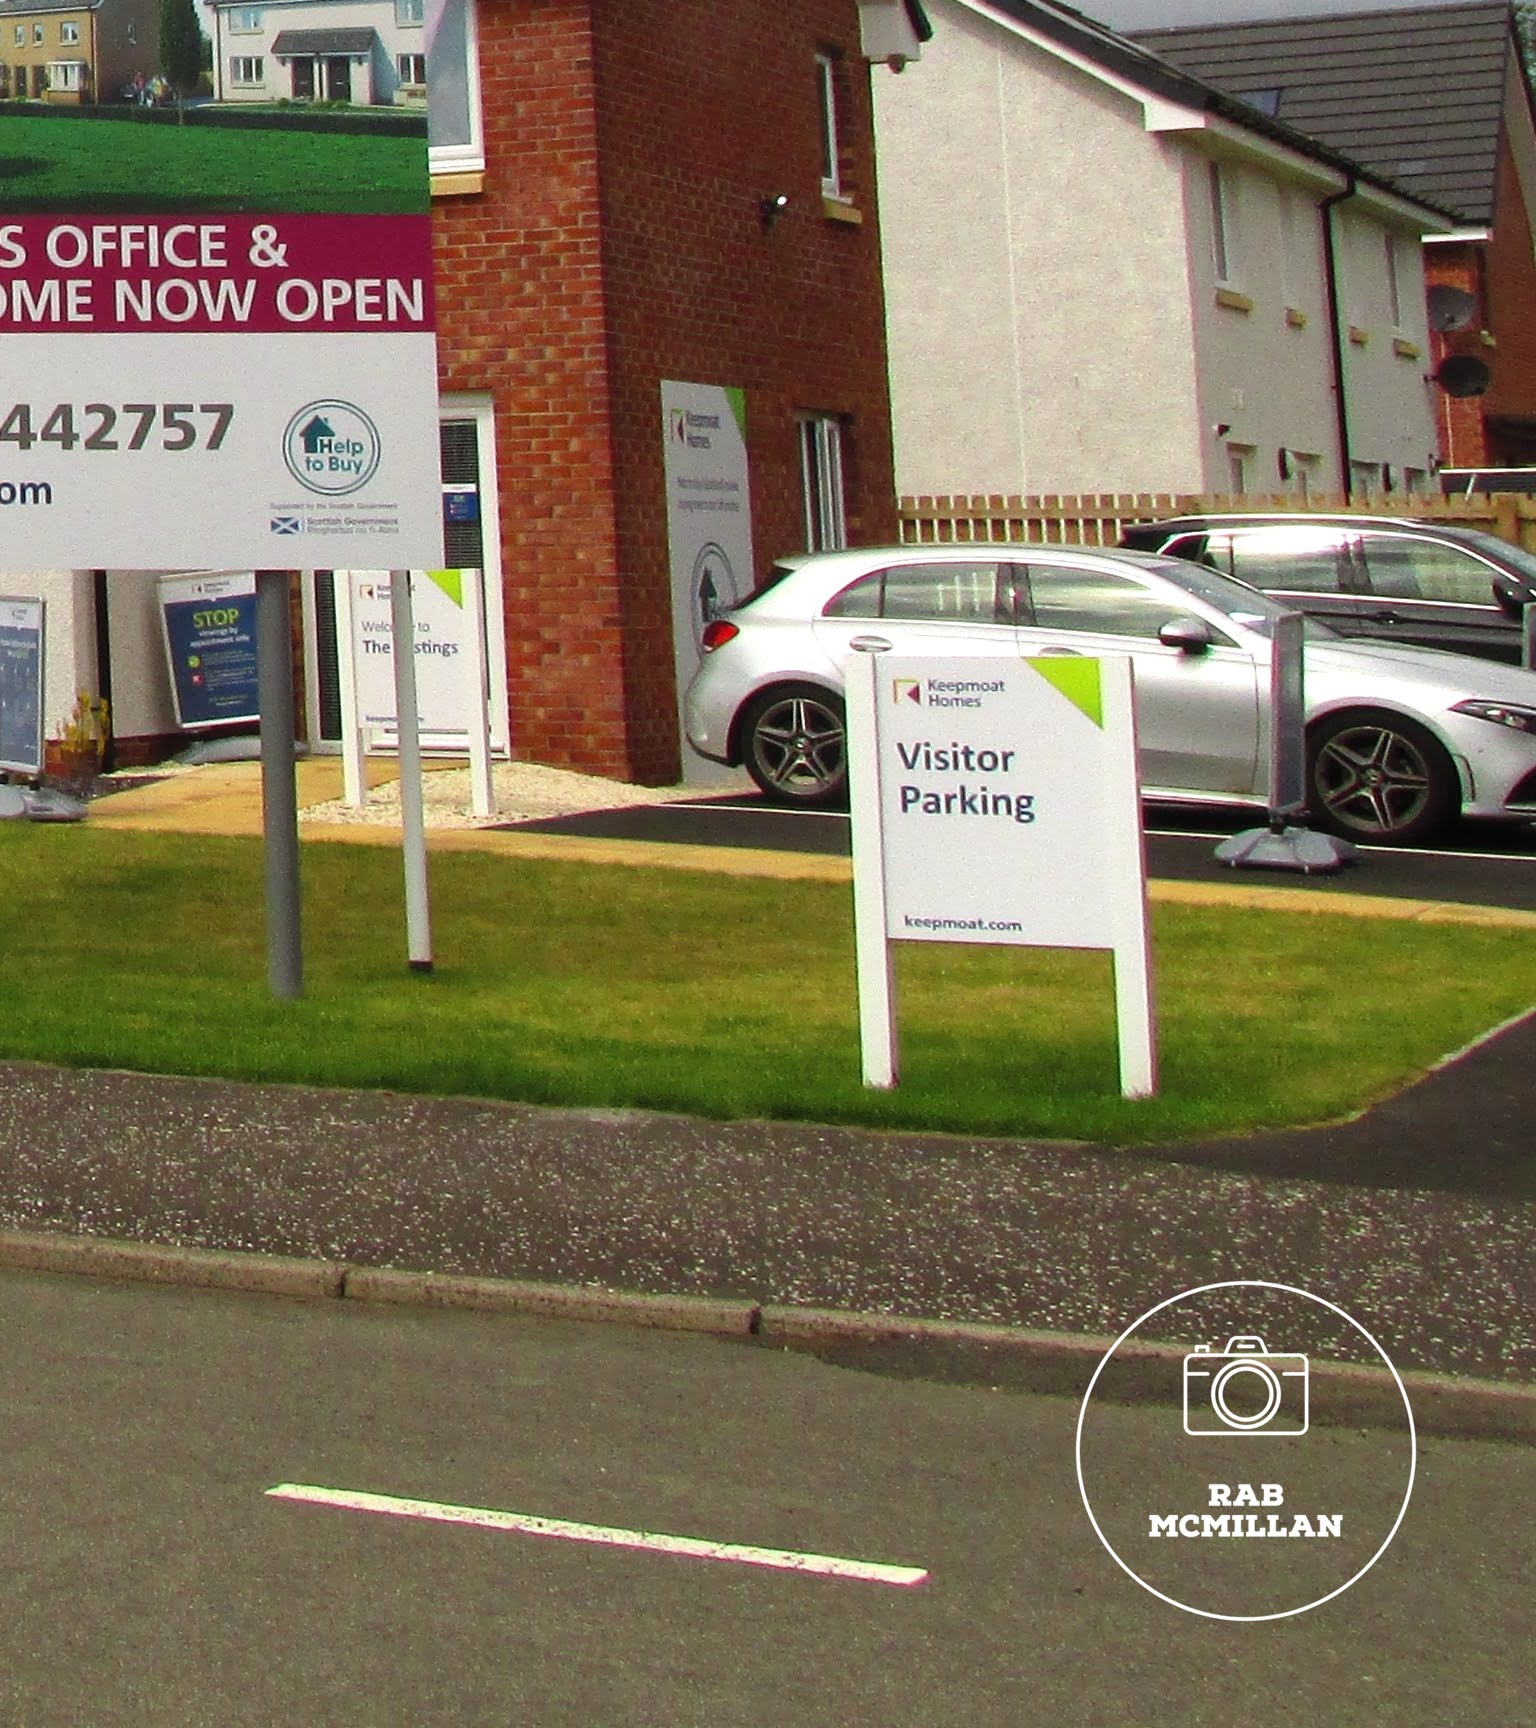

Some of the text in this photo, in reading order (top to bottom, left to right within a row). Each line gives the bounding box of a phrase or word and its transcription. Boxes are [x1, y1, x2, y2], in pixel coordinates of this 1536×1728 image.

[46, 224, 227, 269] OFFICE
[249, 224, 288, 267] &
[115, 278, 256, 323] NOW
[276, 278, 424, 322] OPEN
[319, 438, 363, 456] Help
[305, 457, 363, 474] to Buy
[193, 608, 240, 628] STOP
[418, 622, 430, 632] to
[363, 640, 458, 657] The stings
[928, 679, 1005, 693] Keepmoat
[928, 694, 981, 708] Homes
[896, 742, 1015, 772] Visitor
[900, 785, 1035, 823] Parking
[904, 915, 1022, 932] keepmoat.com
